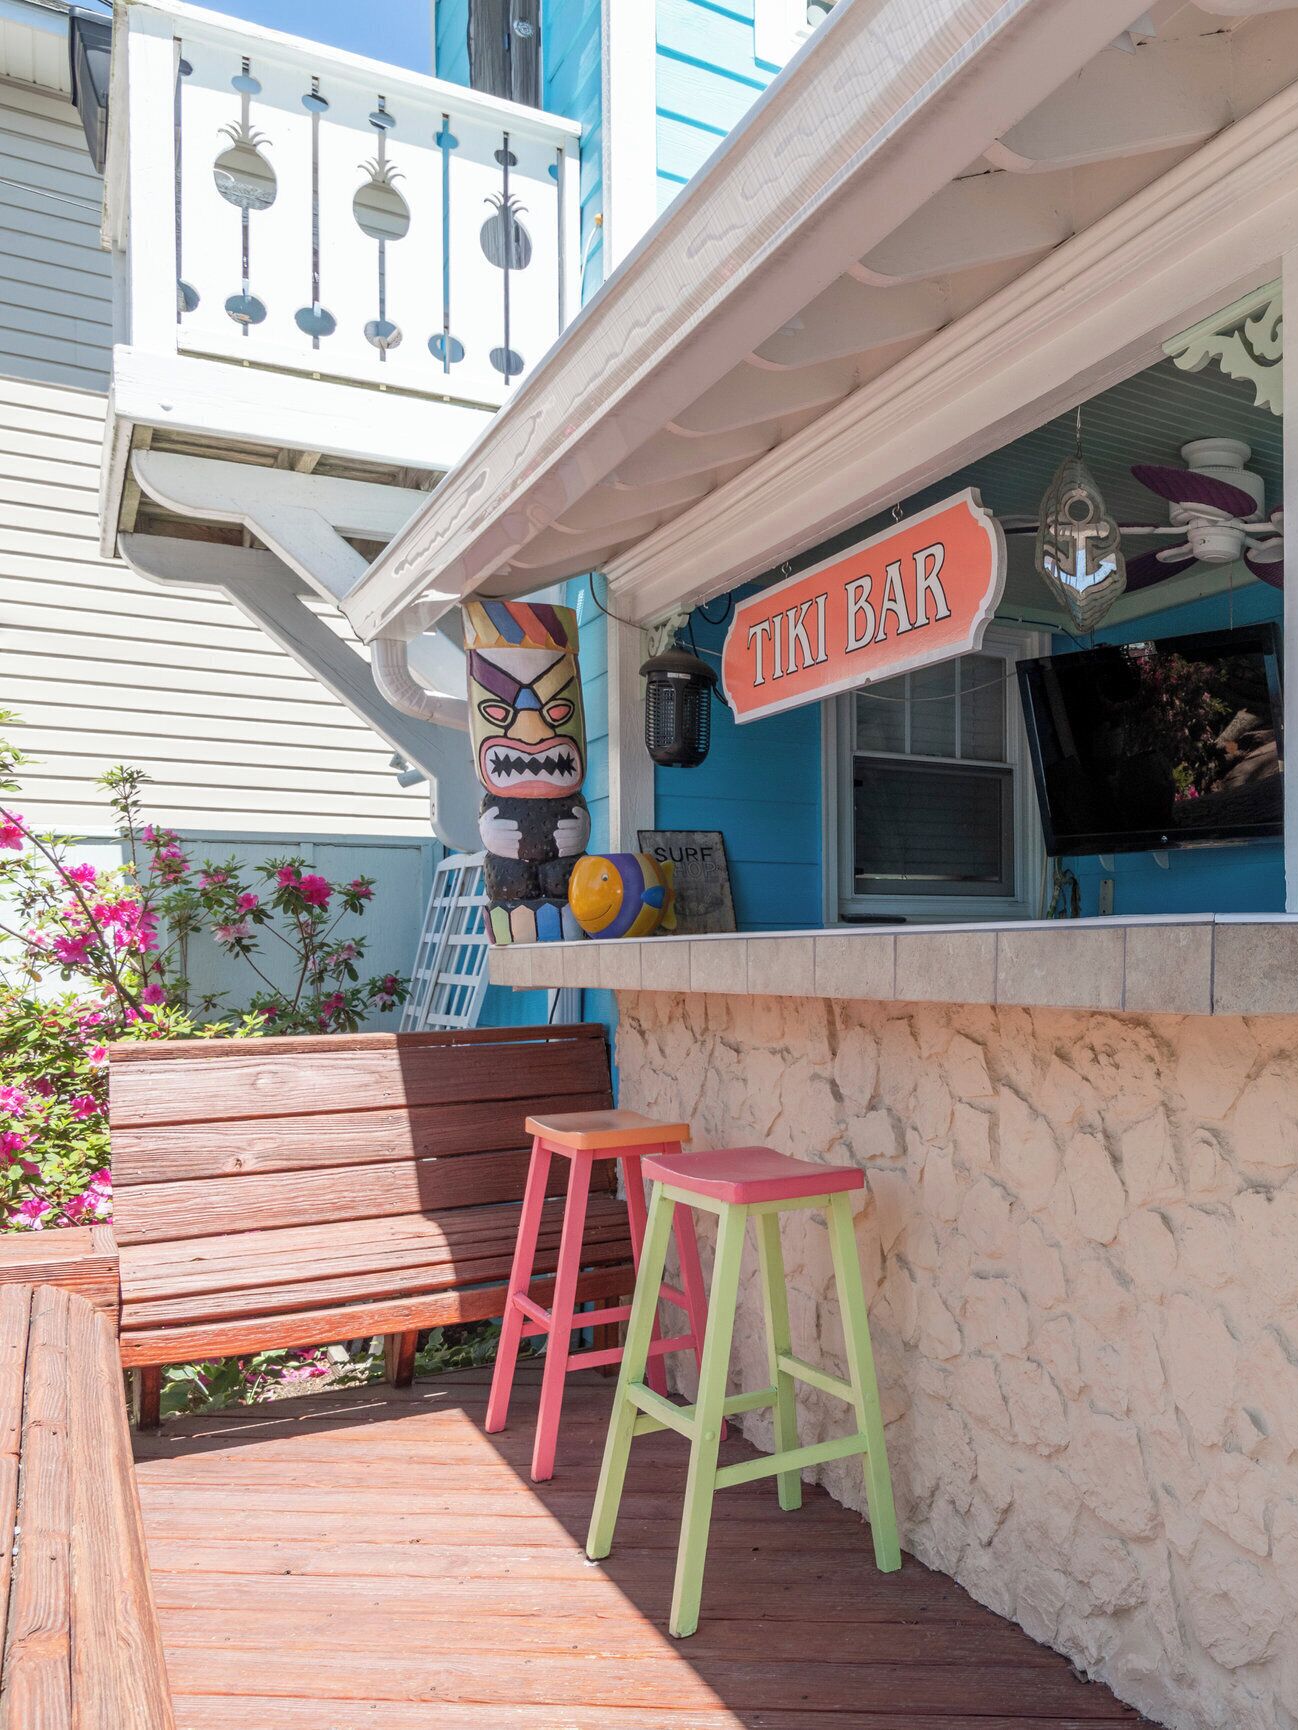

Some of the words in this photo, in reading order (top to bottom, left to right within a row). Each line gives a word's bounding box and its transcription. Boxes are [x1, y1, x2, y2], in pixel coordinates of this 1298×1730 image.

[747, 592, 829, 687] TIKI
[844, 541, 952, 654] BAR
[654, 847, 714, 863] SURF
[672, 861, 717, 880] HOP
